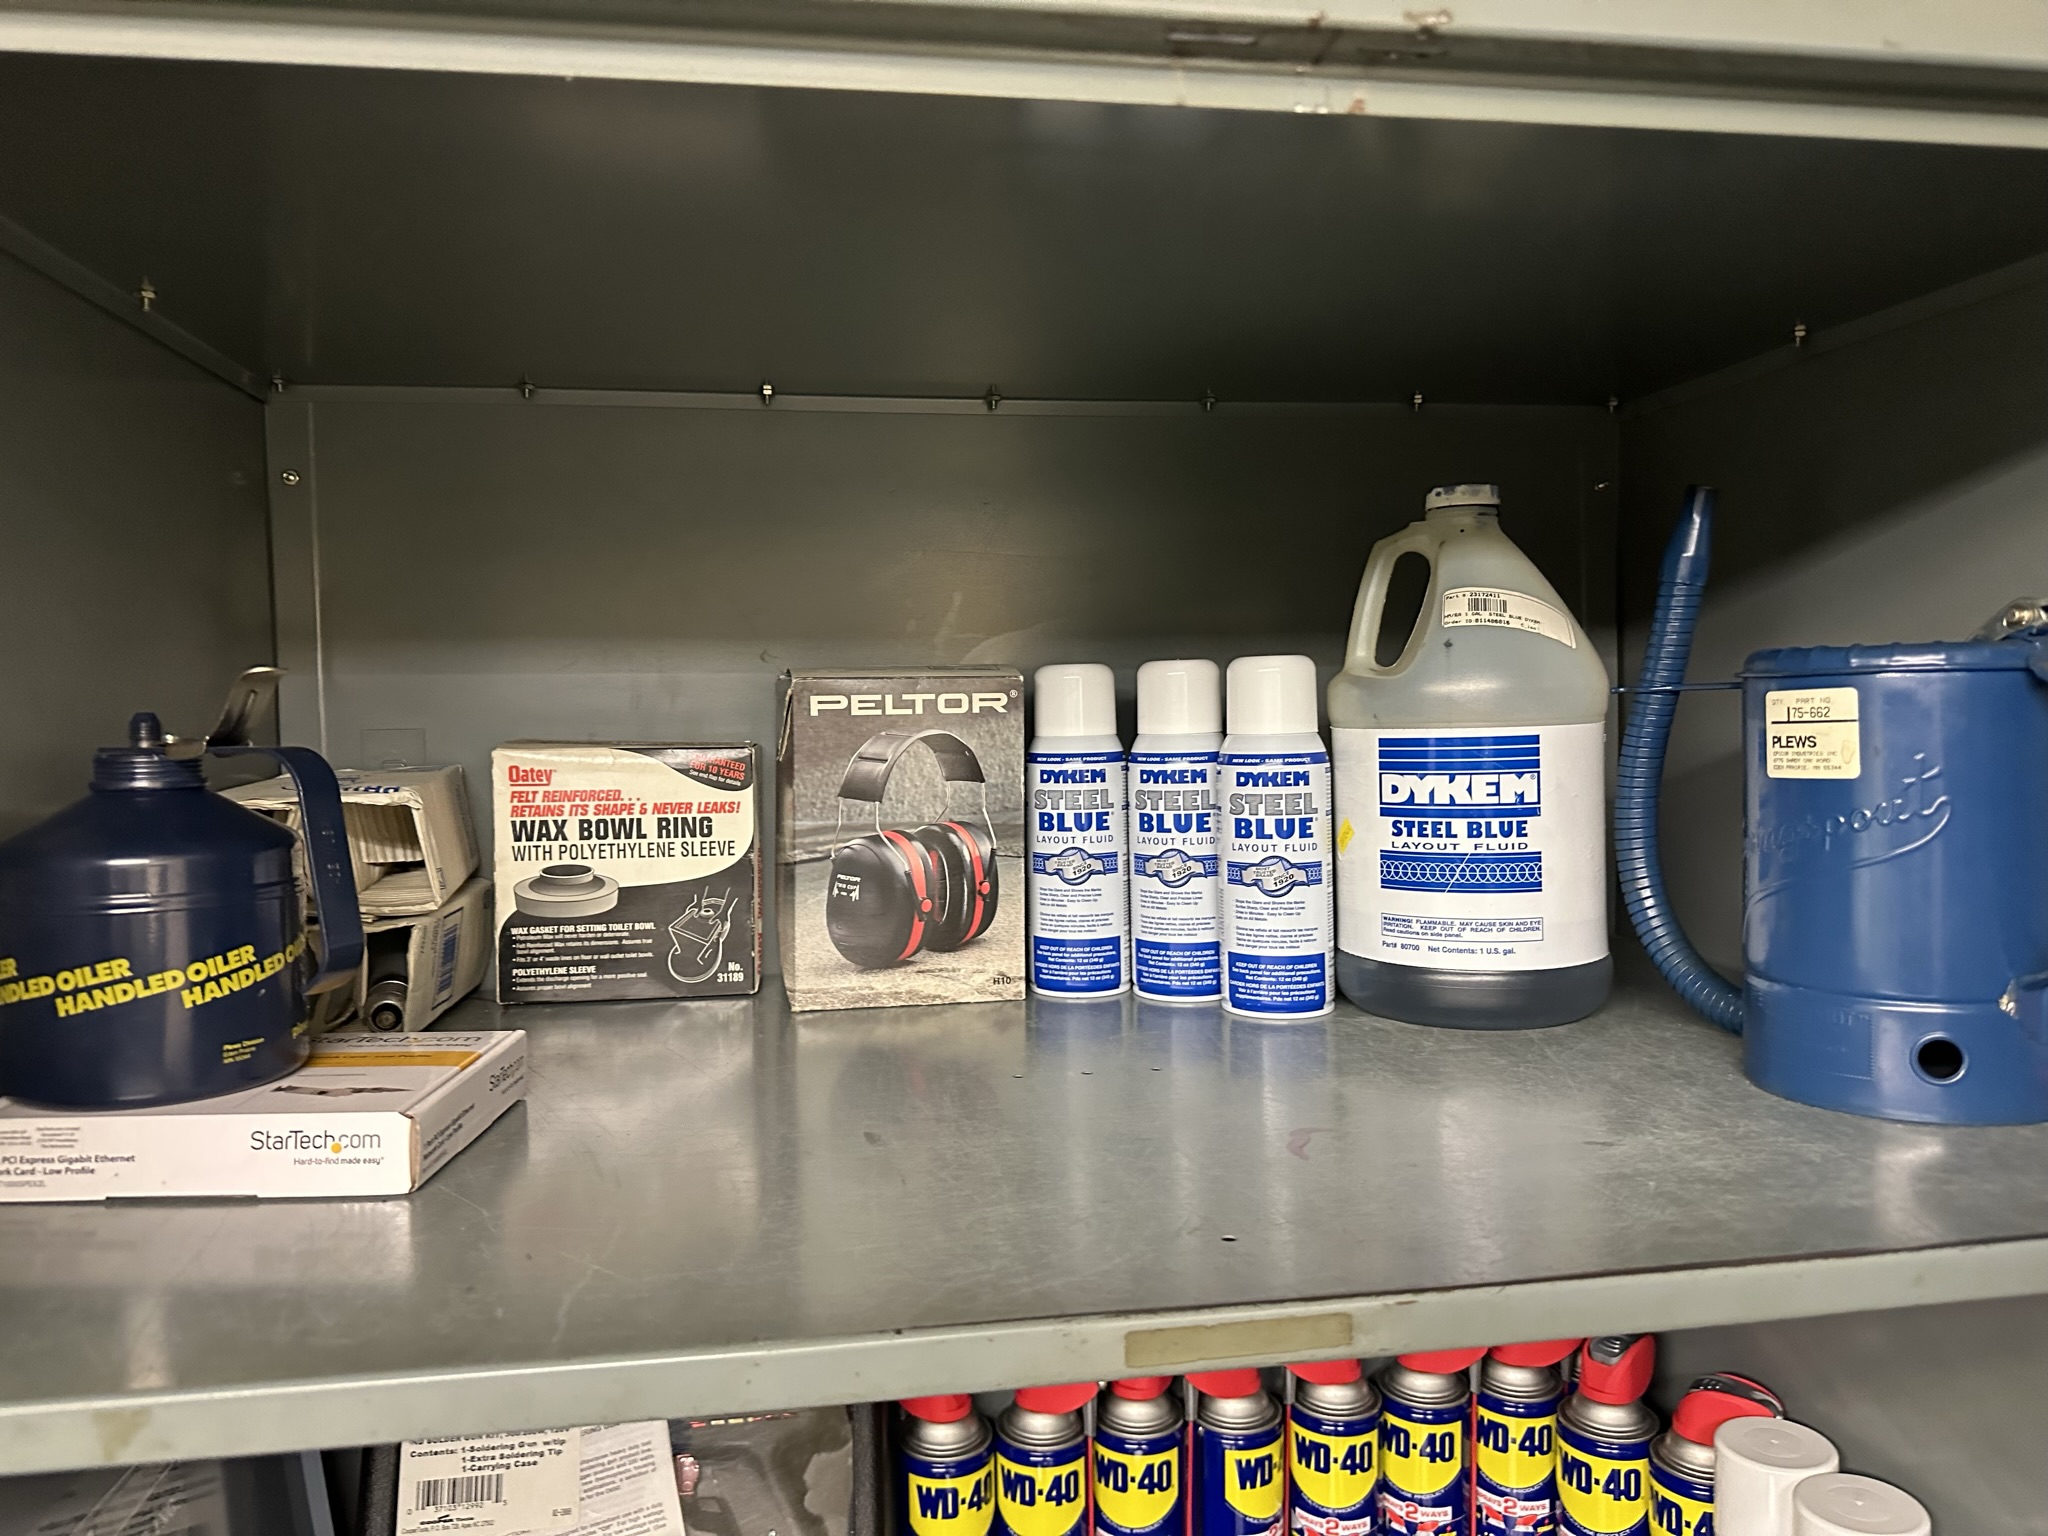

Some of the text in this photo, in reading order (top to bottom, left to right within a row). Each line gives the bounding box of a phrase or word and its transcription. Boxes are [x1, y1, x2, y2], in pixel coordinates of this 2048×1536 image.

[1792, 706, 1830, 718] 75-662
[1772, 735, 1817, 748] PLEWS
[508, 764, 553, 786] Oatey
[708, 765, 718, 774] 10
[720, 768, 745, 780] YEARS
[1040, 769, 1106, 784] DYKEM
[1140, 769, 1206, 784] DYKEM
[1236, 770, 1309, 787] DYKEM
[510, 790, 539, 803] FELT
[1034, 789, 1114, 810] STEEL
[1135, 790, 1216, 811] STEEL
[1229, 792, 1318, 816] STEEL
[510, 801, 740, 818] RETAINS ITS SHAPE & NEVER LEAKS!
[510, 816, 713, 842] WAX BOWL RING
[1039, 811, 1110, 832] BLUE
[1139, 812, 1211, 833] BLUE
[1234, 817, 1313, 839] BLUE
[1391, 820, 1528, 838] STEEL BLUE
[1036, 835, 1113, 844] LAYOUT FLUID
[1137, 836, 1215, 845] LAYOUT FLUID
[1232, 842, 1317, 852] LAYOUT FLUID
[1392, 841, 1528, 850] LAYOUT FLUID
[512, 840, 735, 861] WITH POLYETHYLENE SLEEVE
[1072, 864, 1092, 876] 1920
[1172, 866, 1192, 878] 1920
[1273, 874, 1294, 887] 1920
[529, 926, 558, 934] GASKET
[560, 925, 575, 933] FOR
[576, 924, 606, 932] SETTING
[608, 923, 633, 931] TOILET
[635, 922, 656, 930] BOWL
[1383, 916, 1413, 924] WARNING!
[1400, 943, 1420, 951] 80700
[1442, 946, 1478, 954] Contents:
[1503, 948, 1516, 956] gal.
[55, 958, 134, 992] OILER
[512, 965, 597, 976] POLYETHYLENE SLEEVE
[728, 962, 743, 972] No.
[54, 968, 186, 1018] HANDLED
[186, 944, 258, 982] OILER
[180, 952, 286, 1009] HANDLED
[717, 972, 744, 983] 31189
[993, 976, 1011, 986] H10
[250, 1130, 381, 1153] StarTech.com
[2, 1155, 135, 1165] PCI Express Gigabit Ethernet
[294, 1157, 339, 1165] Hard-to-find
[340, 1157, 361, 1165] made
[14, 1166, 95, 1176] Card Low Profile
[1380, 1418, 1454, 1463] WD-40
[1478, 1414, 1552, 1457] WD-40
[410, 1448, 458, 1458] Contents:
[461, 1442, 515, 1454] 1-Soldering
[462, 1448, 563, 1463] 1-Extra Soldering Tip
[1294, 1431, 1372, 1475] WD-40
[462, 1460, 538, 1472] 1-Carrying Case
[1559, 1446, 1641, 1501] WD-40
[1094, 1454, 1172, 1495] WD-40
[1000, 1463, 1079, 1507] WD-40
[916, 1470, 992, 1520] WD-40
[1405, 1503, 1449, 1520] 2 WAYS
[1503, 1498, 1546, 1514] 2 WAYS
[1325, 1519, 1368, 1535] 2 WAYS
